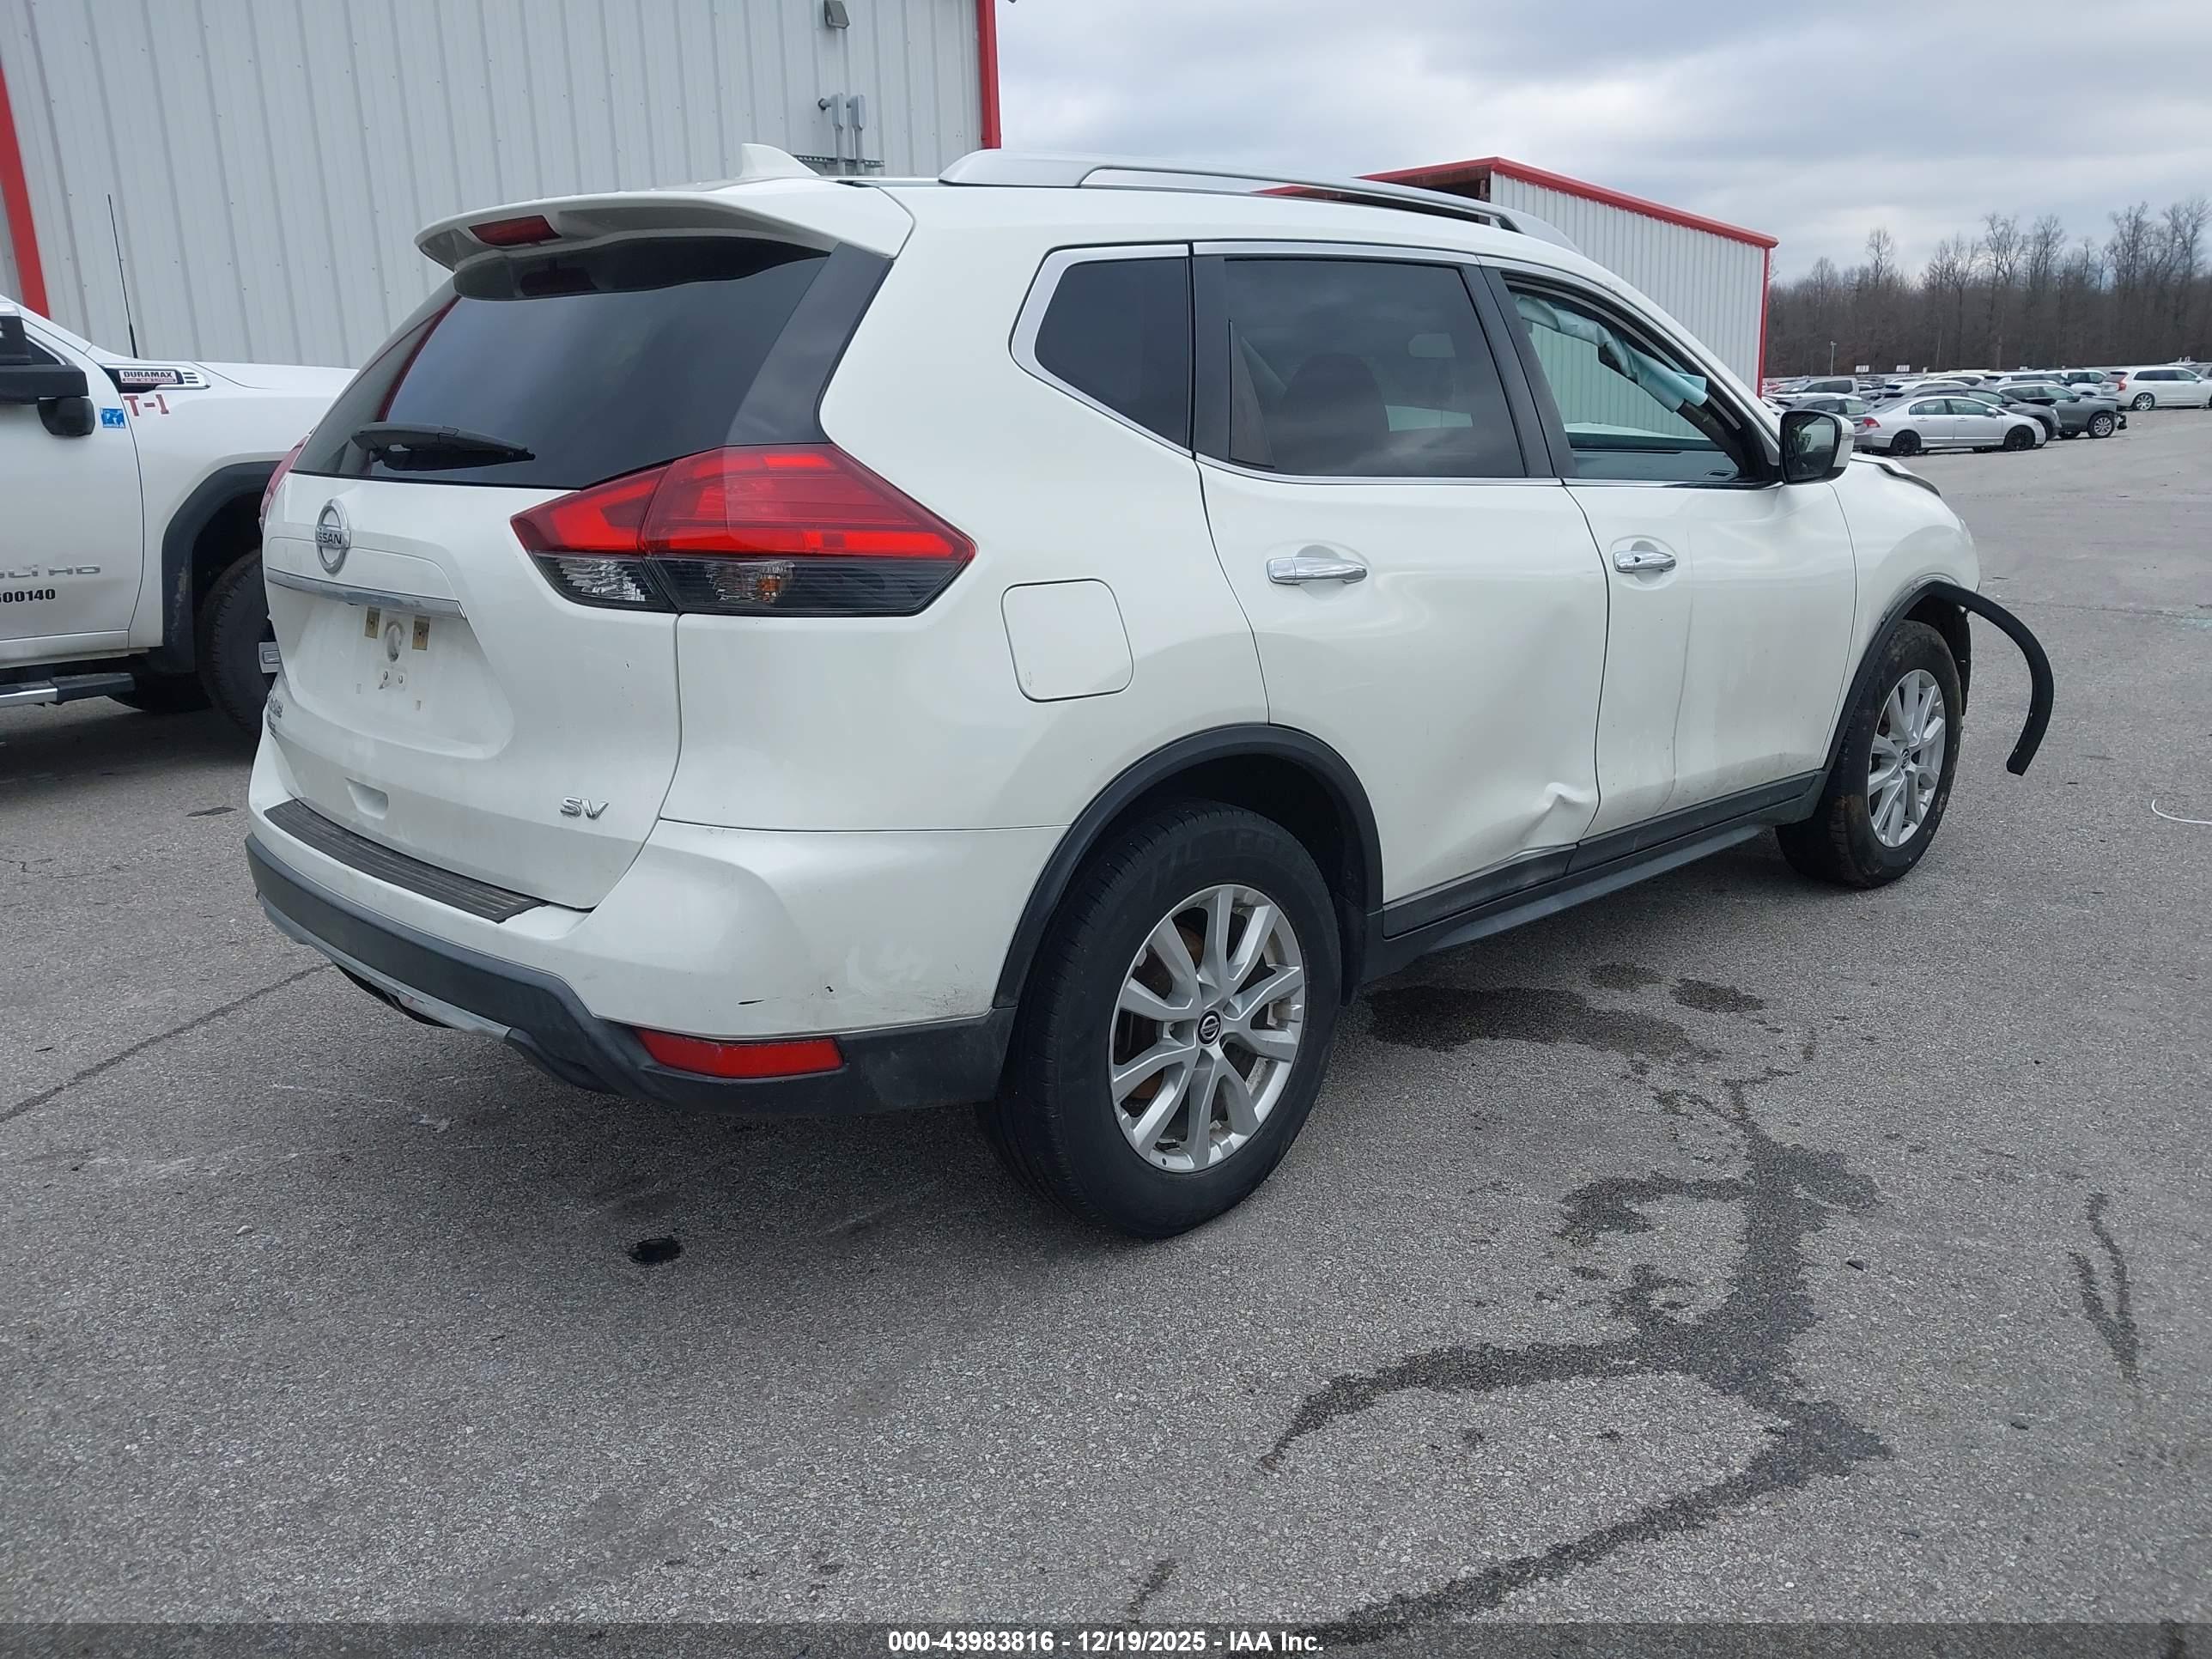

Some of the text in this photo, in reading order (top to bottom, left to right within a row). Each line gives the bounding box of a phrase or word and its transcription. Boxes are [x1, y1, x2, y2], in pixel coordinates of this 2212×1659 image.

[122, 393, 170, 416] T-1
[0, 588, 56, 603] 00140
[560, 797, 609, 820] SV
